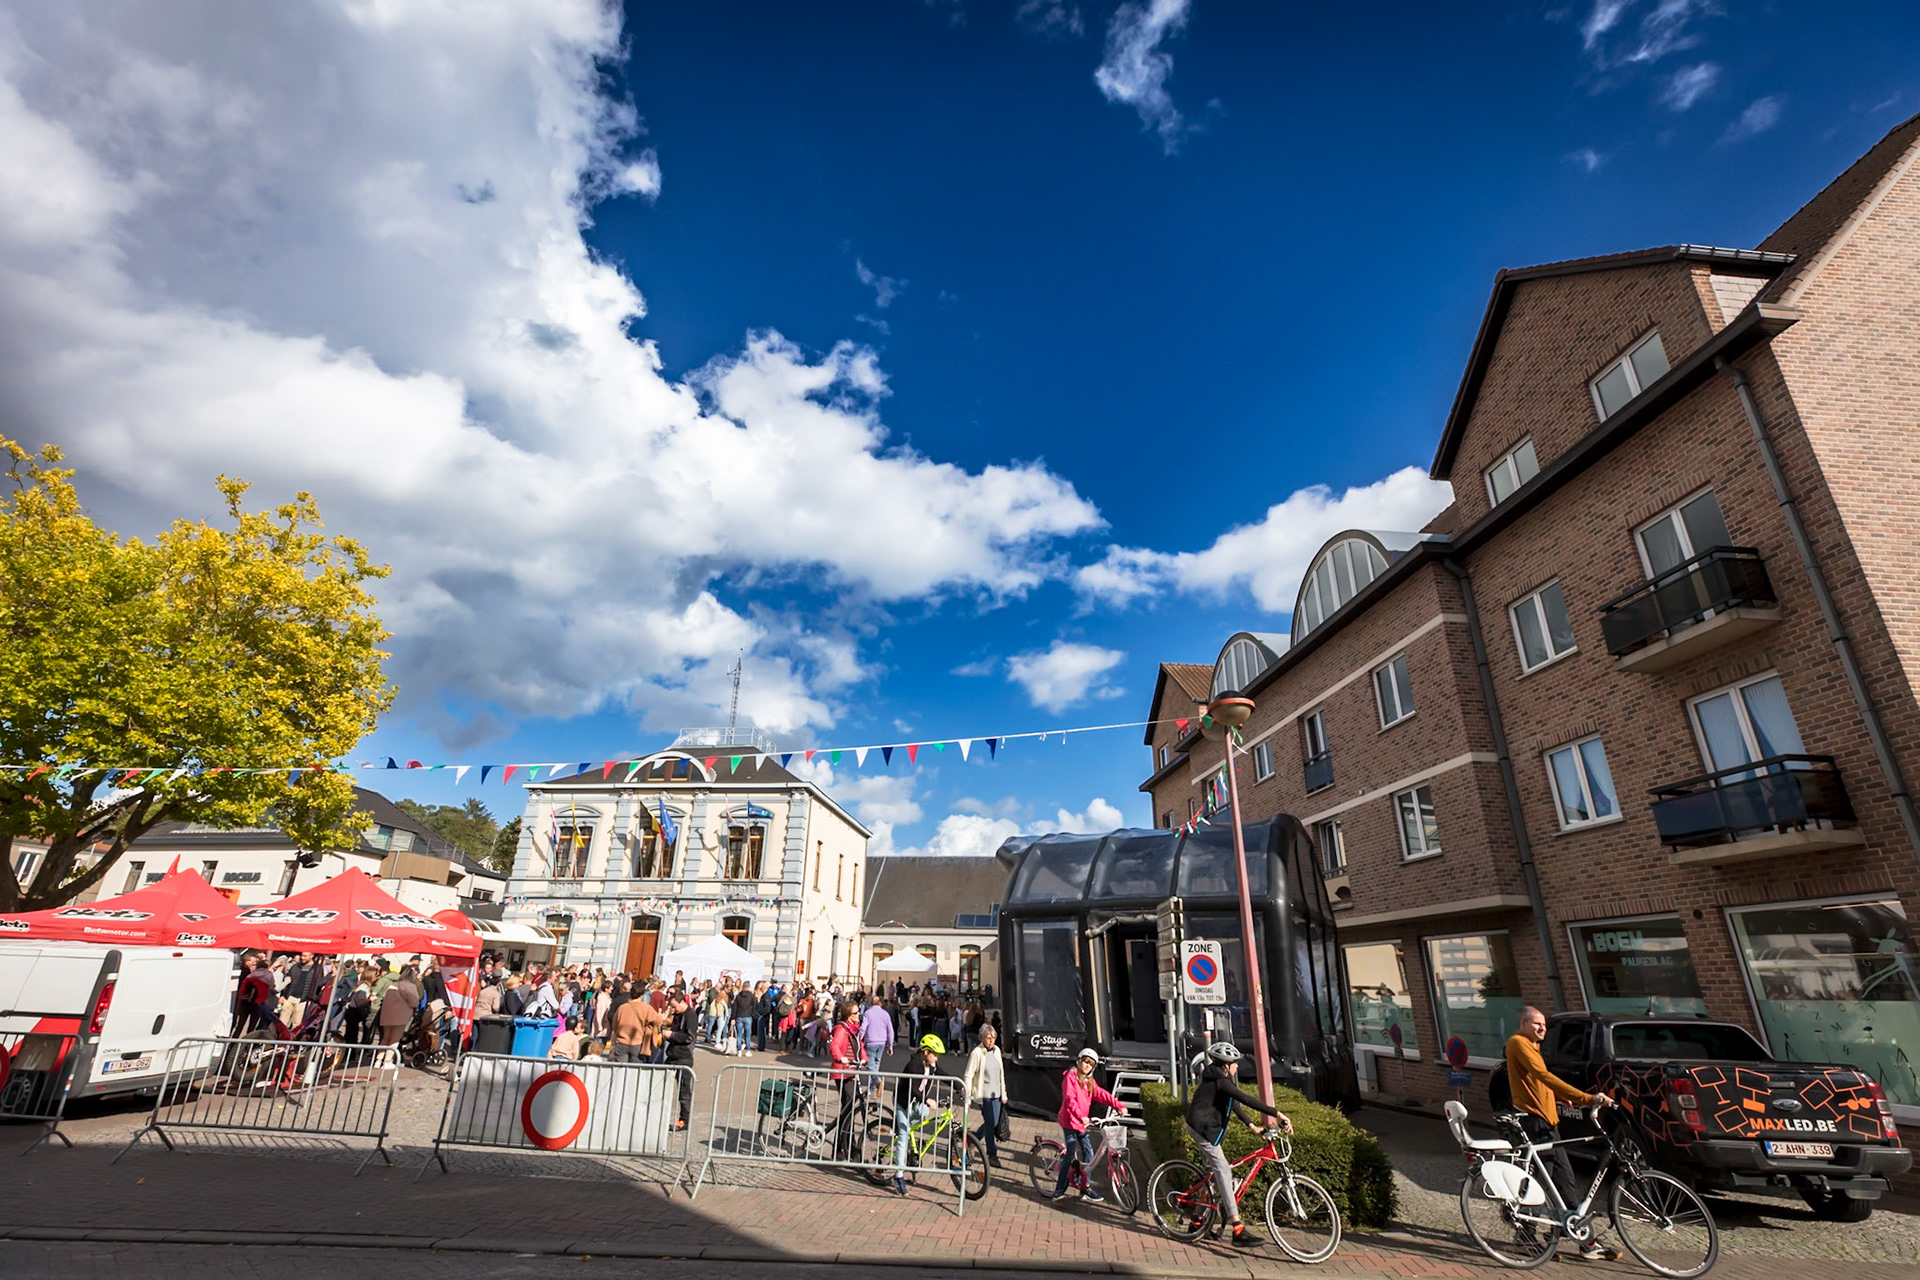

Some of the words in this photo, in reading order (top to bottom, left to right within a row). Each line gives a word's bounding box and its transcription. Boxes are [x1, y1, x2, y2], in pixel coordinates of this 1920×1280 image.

[240, 907, 339, 919] Beta
[359, 910, 438, 925] Beta
[177, 933, 215, 942] Beta
[361, 936, 393, 944] Beta
[1187, 943, 1213, 953] ZONE
[1749, 1118, 1838, 1132] MAXLED.BE
